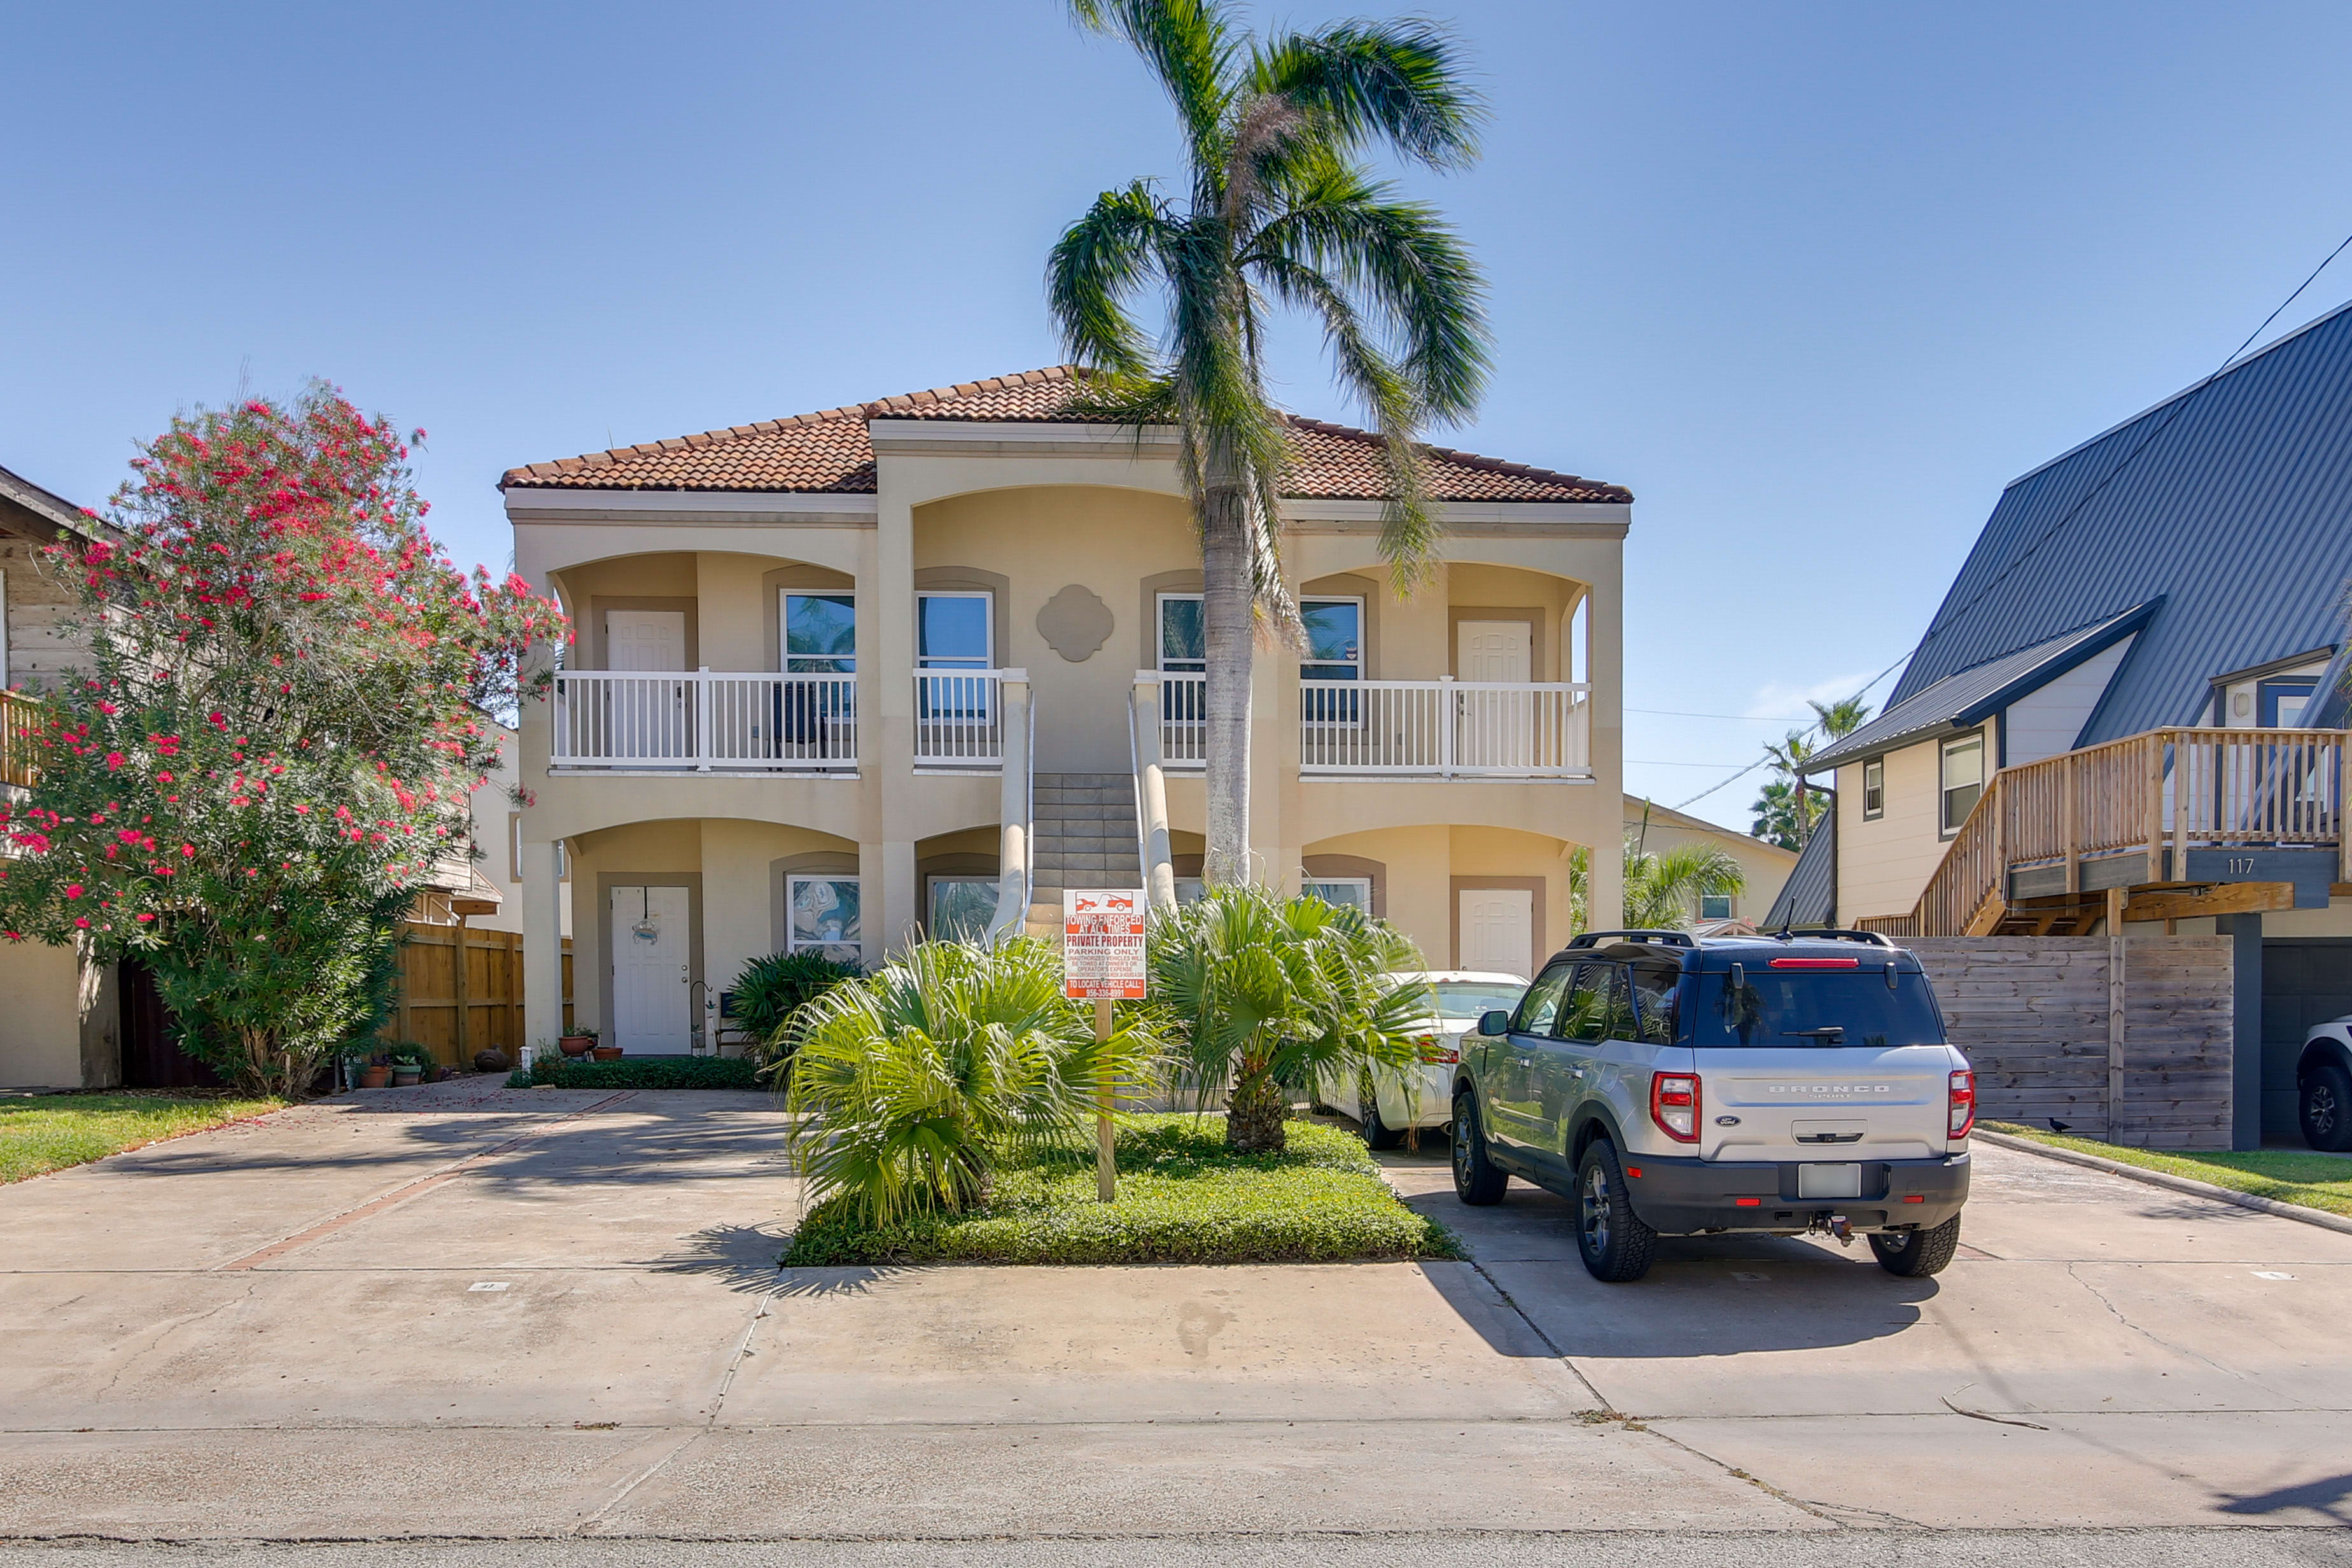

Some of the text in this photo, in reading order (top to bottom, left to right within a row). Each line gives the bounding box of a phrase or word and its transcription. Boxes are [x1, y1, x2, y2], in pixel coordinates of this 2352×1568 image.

[2229, 858, 2254, 874] 117
[1066, 915, 1142, 925] TOWING ENFORCED
[1079, 925, 1130, 934] AT ALL TIMES
[1067, 935, 1143, 947] PRIVATE PROPERTY
[1069, 980, 1141, 988] TO LOCATE VEHICLE CALL:
[1769, 1085, 1889, 1093] BRONCO
